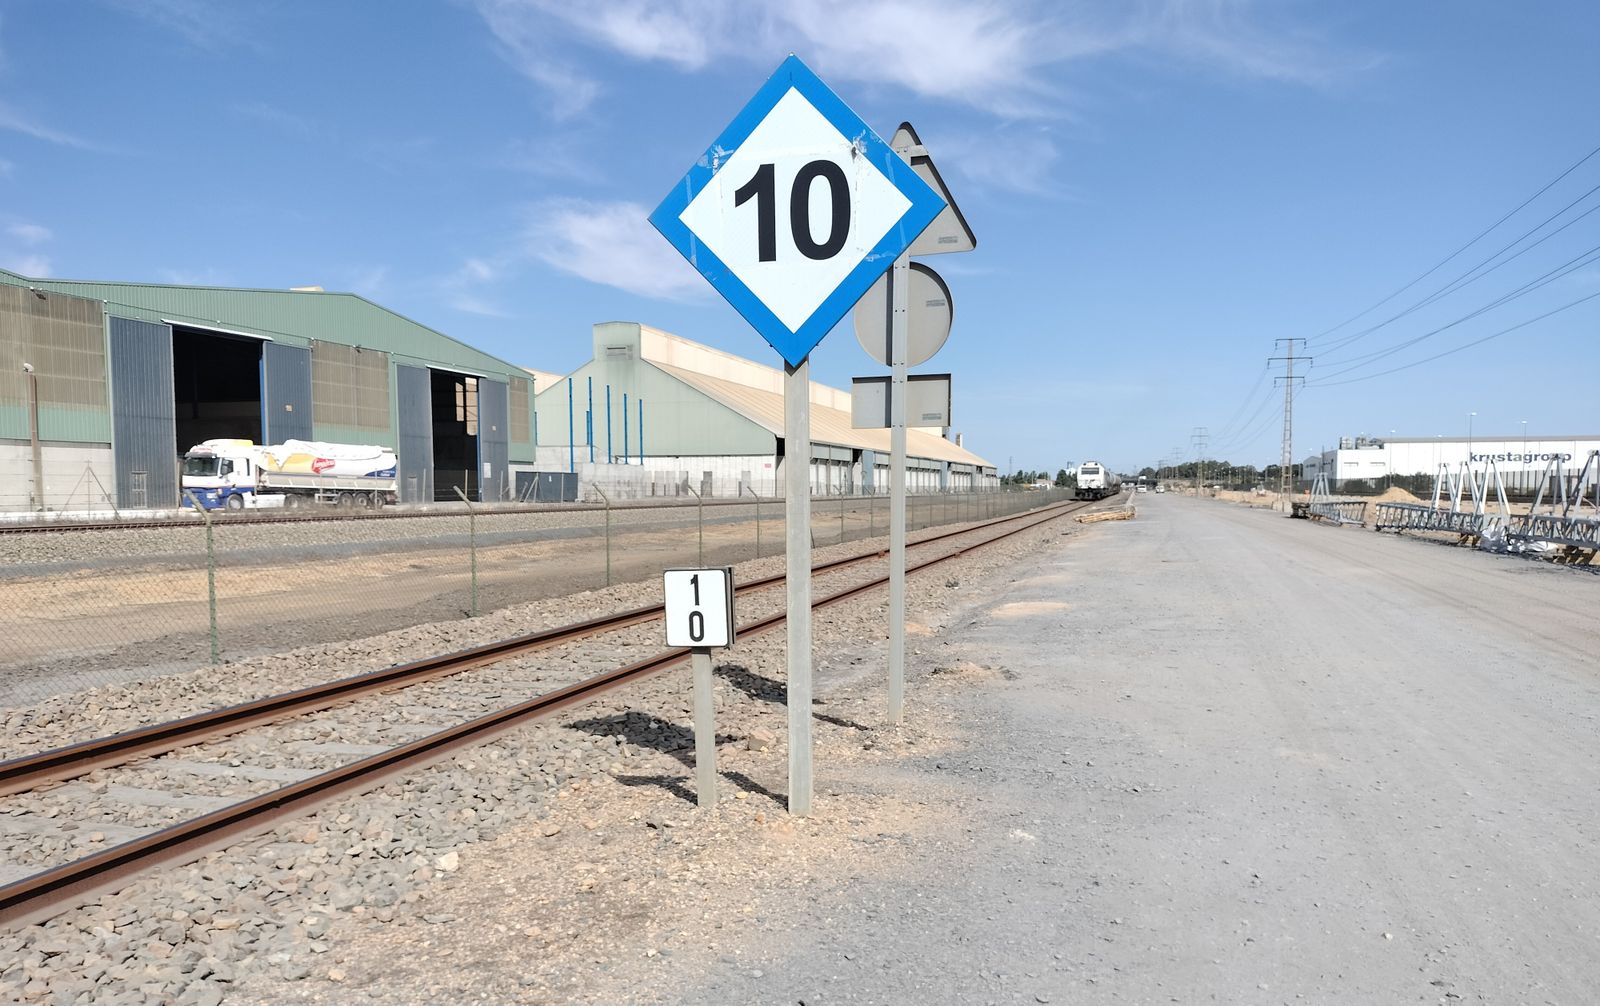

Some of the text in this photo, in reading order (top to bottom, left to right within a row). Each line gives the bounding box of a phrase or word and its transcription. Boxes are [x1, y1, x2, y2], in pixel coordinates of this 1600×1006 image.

[735, 160, 850, 262] 10
[1470, 452, 1572, 463] krustagrop
[690, 574, 700, 606] 1
[689, 611, 704, 642] 0
